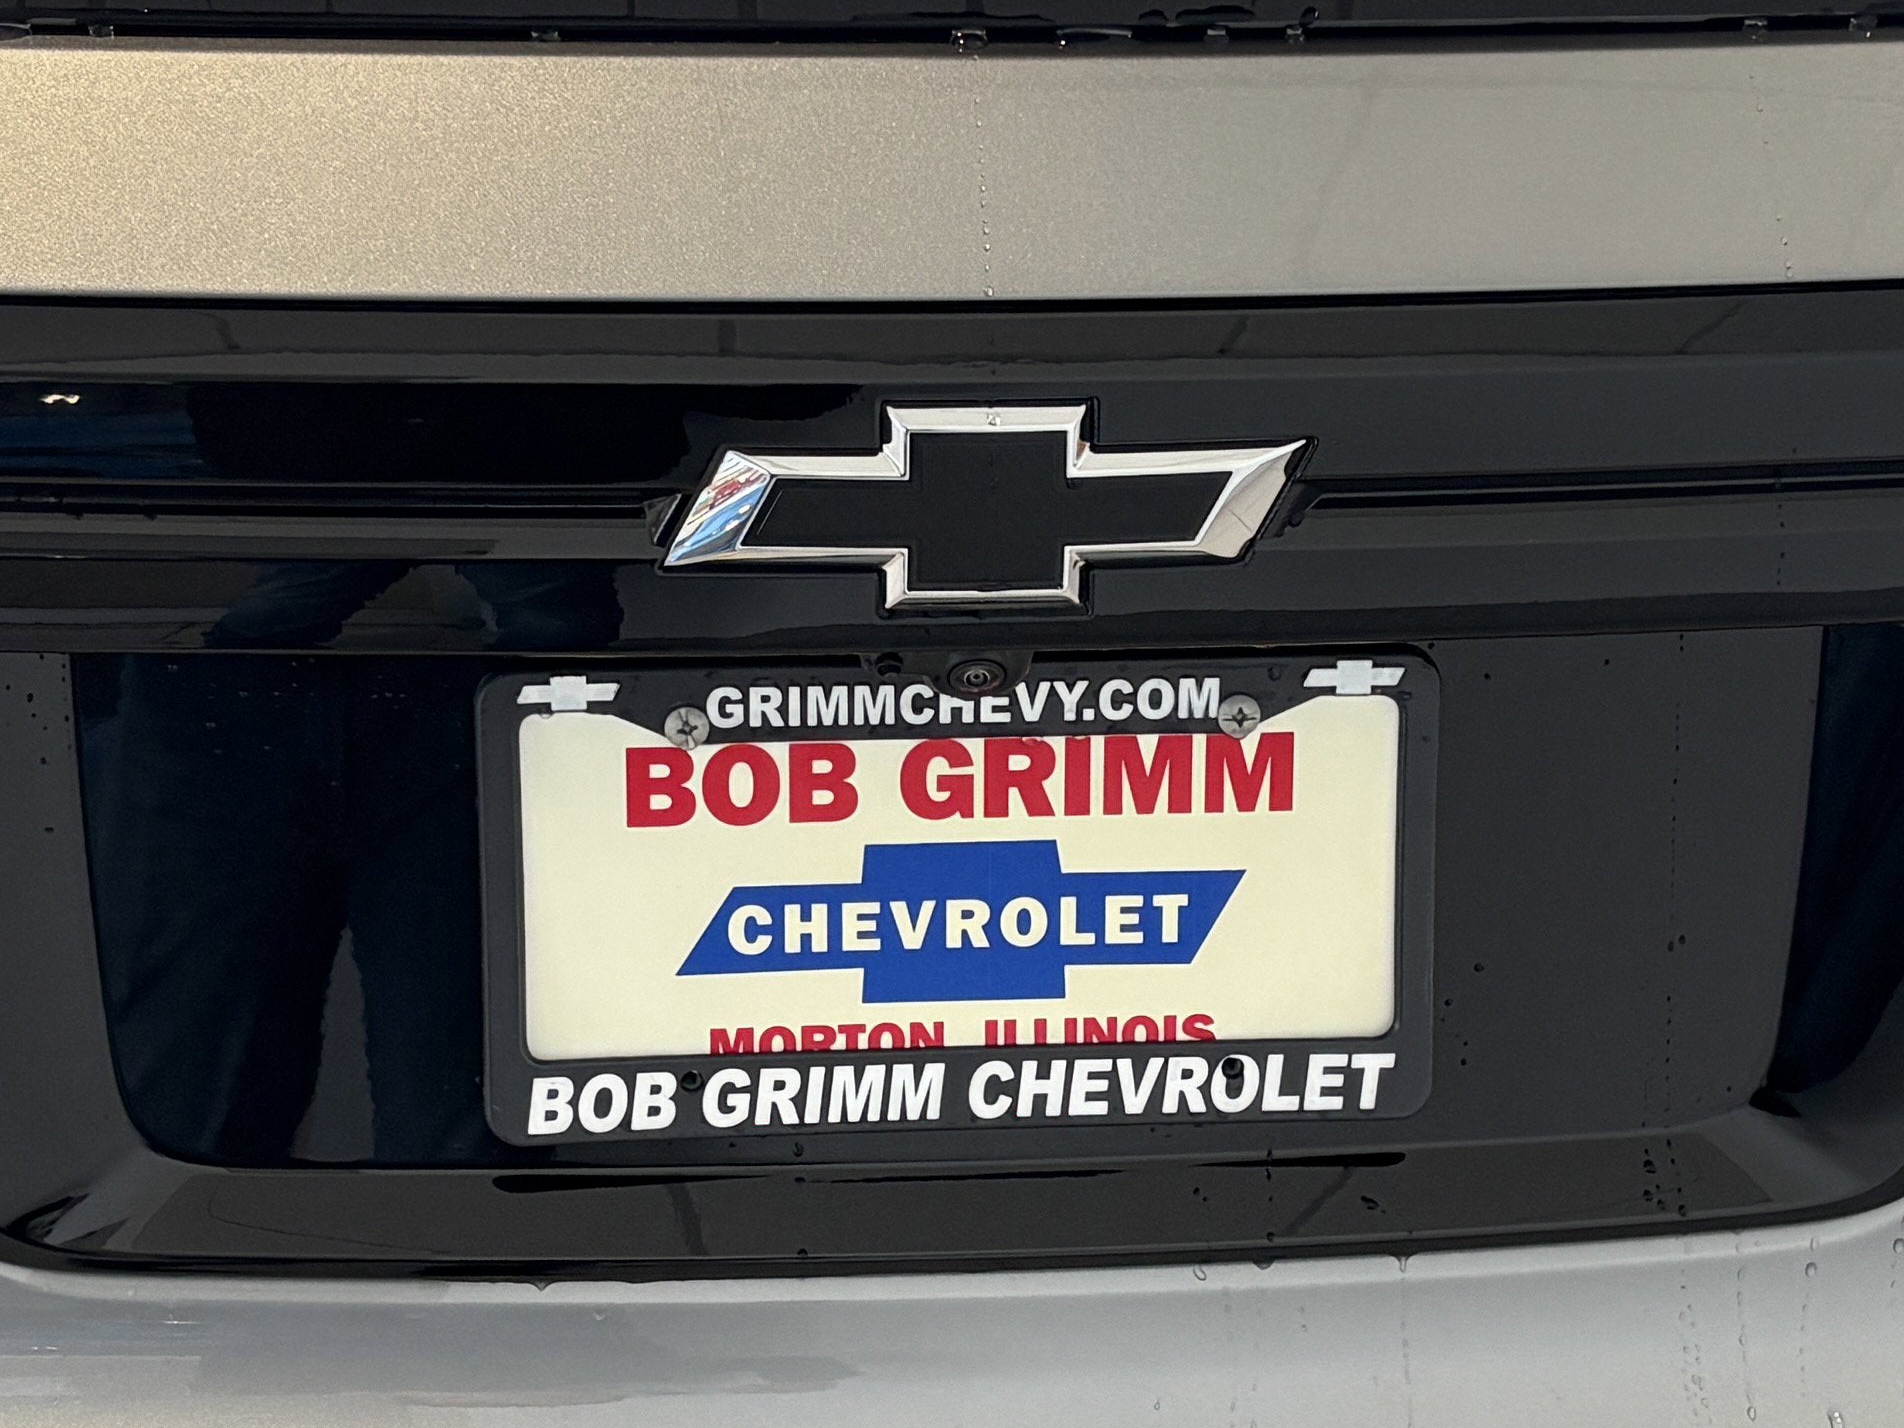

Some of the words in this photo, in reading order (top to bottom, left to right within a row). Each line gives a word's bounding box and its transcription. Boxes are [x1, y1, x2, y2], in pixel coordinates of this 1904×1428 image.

[706, 677, 1221, 729] GRIMMCHEVY.COM
[625, 742, 859, 829] BOB
[899, 731, 1295, 821] GRIMM
[727, 893, 1189, 956] CHEVROLET
[527, 1071, 678, 1136] BOB
[702, 1062, 946, 1128] GRIMM
[968, 1052, 1396, 1120] CHEVROLET
